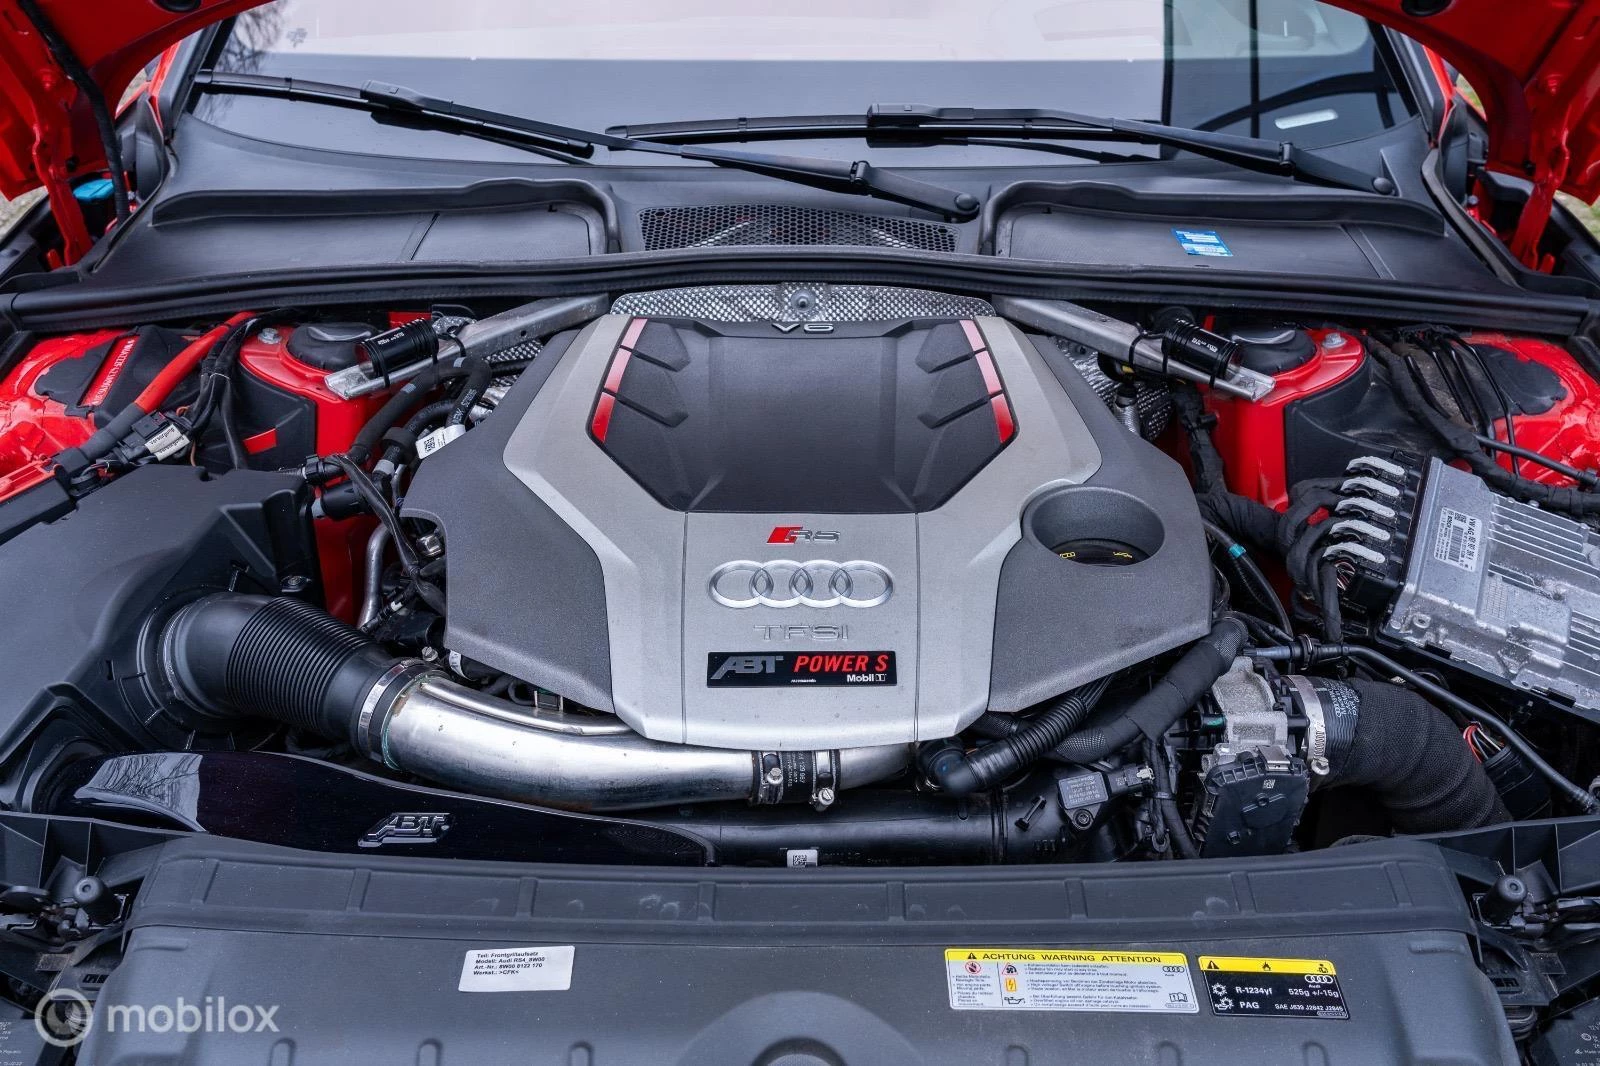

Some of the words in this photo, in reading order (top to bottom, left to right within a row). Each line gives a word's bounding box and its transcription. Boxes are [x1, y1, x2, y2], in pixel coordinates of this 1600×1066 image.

[771, 323, 834, 334] V6
[781, 526, 840, 544] RS
[753, 623, 849, 641] TFSI
[711, 655, 784, 680] ABT
[793, 655, 869, 673] POWER
[874, 654, 889, 673] S
[846, 673, 875, 683] Mobil
[358, 812, 450, 847] ABT
[982, 953, 1035, 961] ACHTUNG
[1041, 953, 1095, 962] WARNING
[1101, 955, 1161, 963] ATTENTION
[1235, 986, 1273, 995] R-1234yf
[1288, 988, 1310, 997] 525g
[1239, 1001, 1260, 1009] PAG
